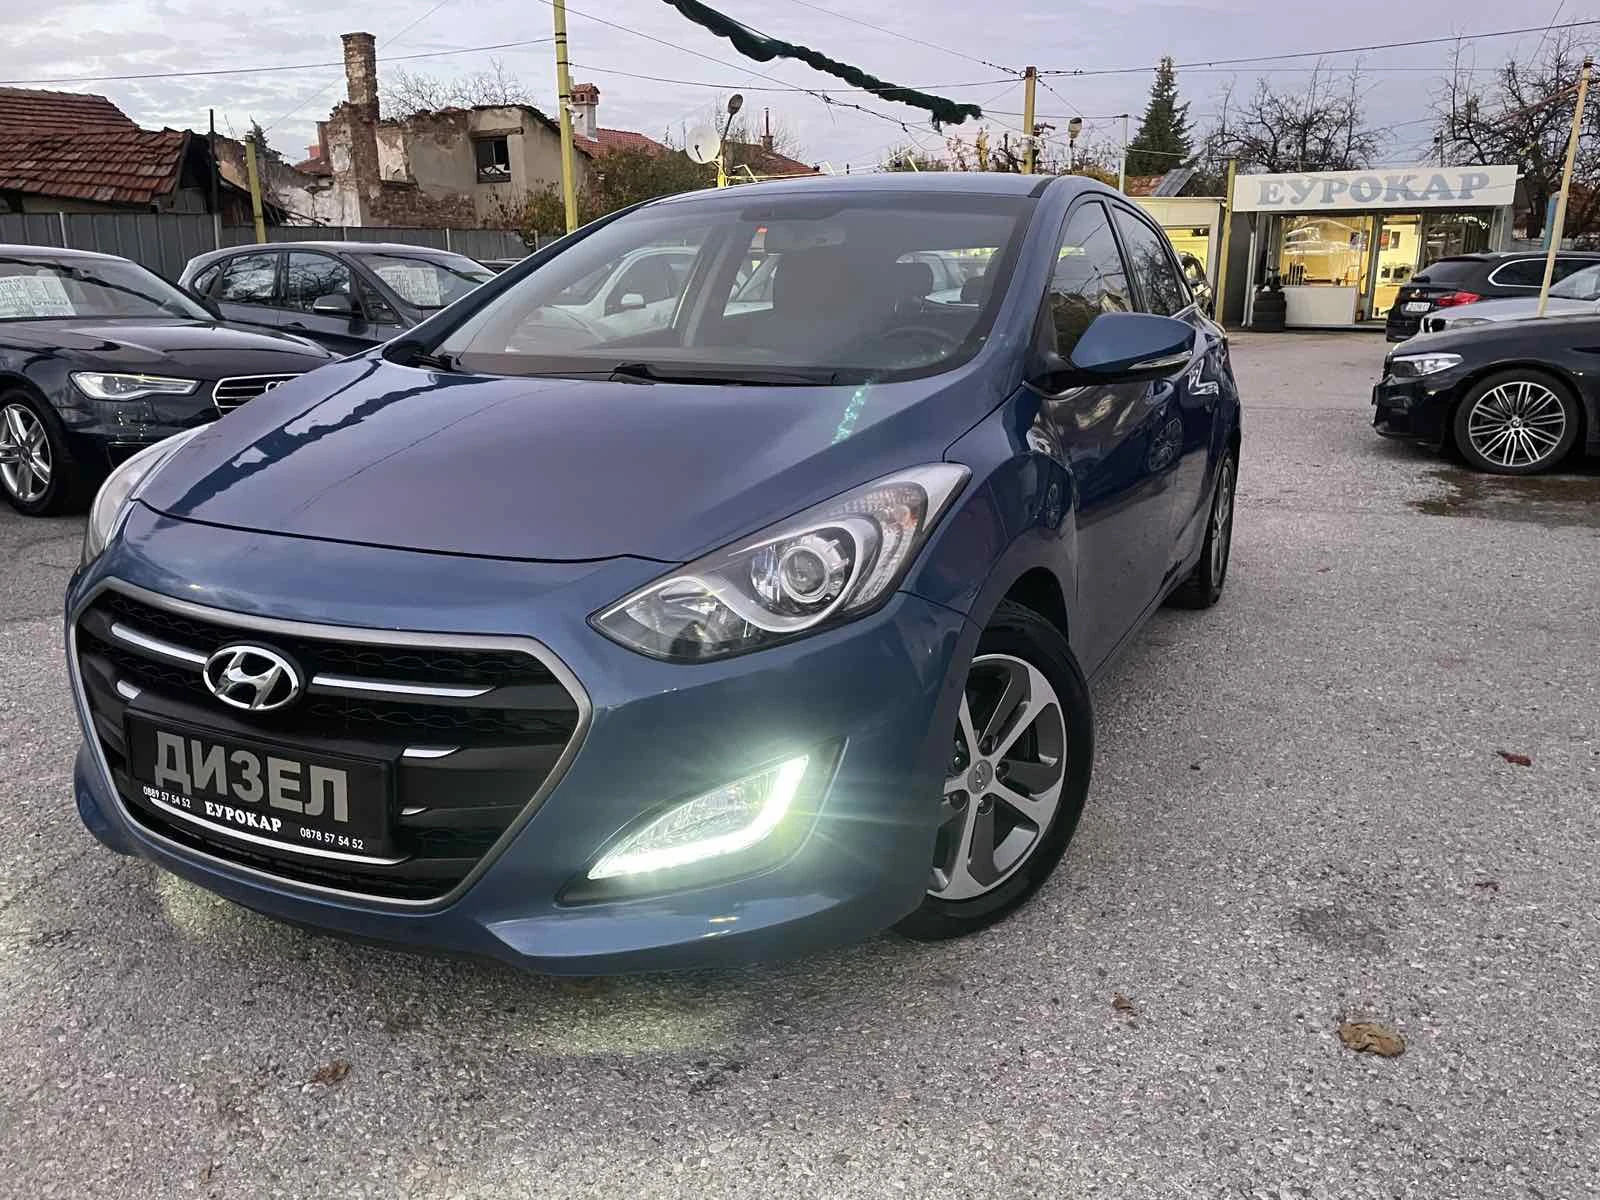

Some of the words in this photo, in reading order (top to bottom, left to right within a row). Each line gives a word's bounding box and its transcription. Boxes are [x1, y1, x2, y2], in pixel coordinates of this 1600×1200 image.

[1257, 171, 1491, 206] ЕУРОКАР
[154, 730, 349, 823] ДИЗЕЛ
[143, 786, 160, 799] 0889
[161, 792, 169, 801] 57
[171, 794, 180, 805] 54
[182, 797, 191, 809] 52
[204, 800, 282, 833] ЕУРОКАР
[300, 827, 322, 841] 0878
[324, 833, 335, 844] 57
[338, 836, 349, 847] 54
[352, 839, 364, 850] 52
